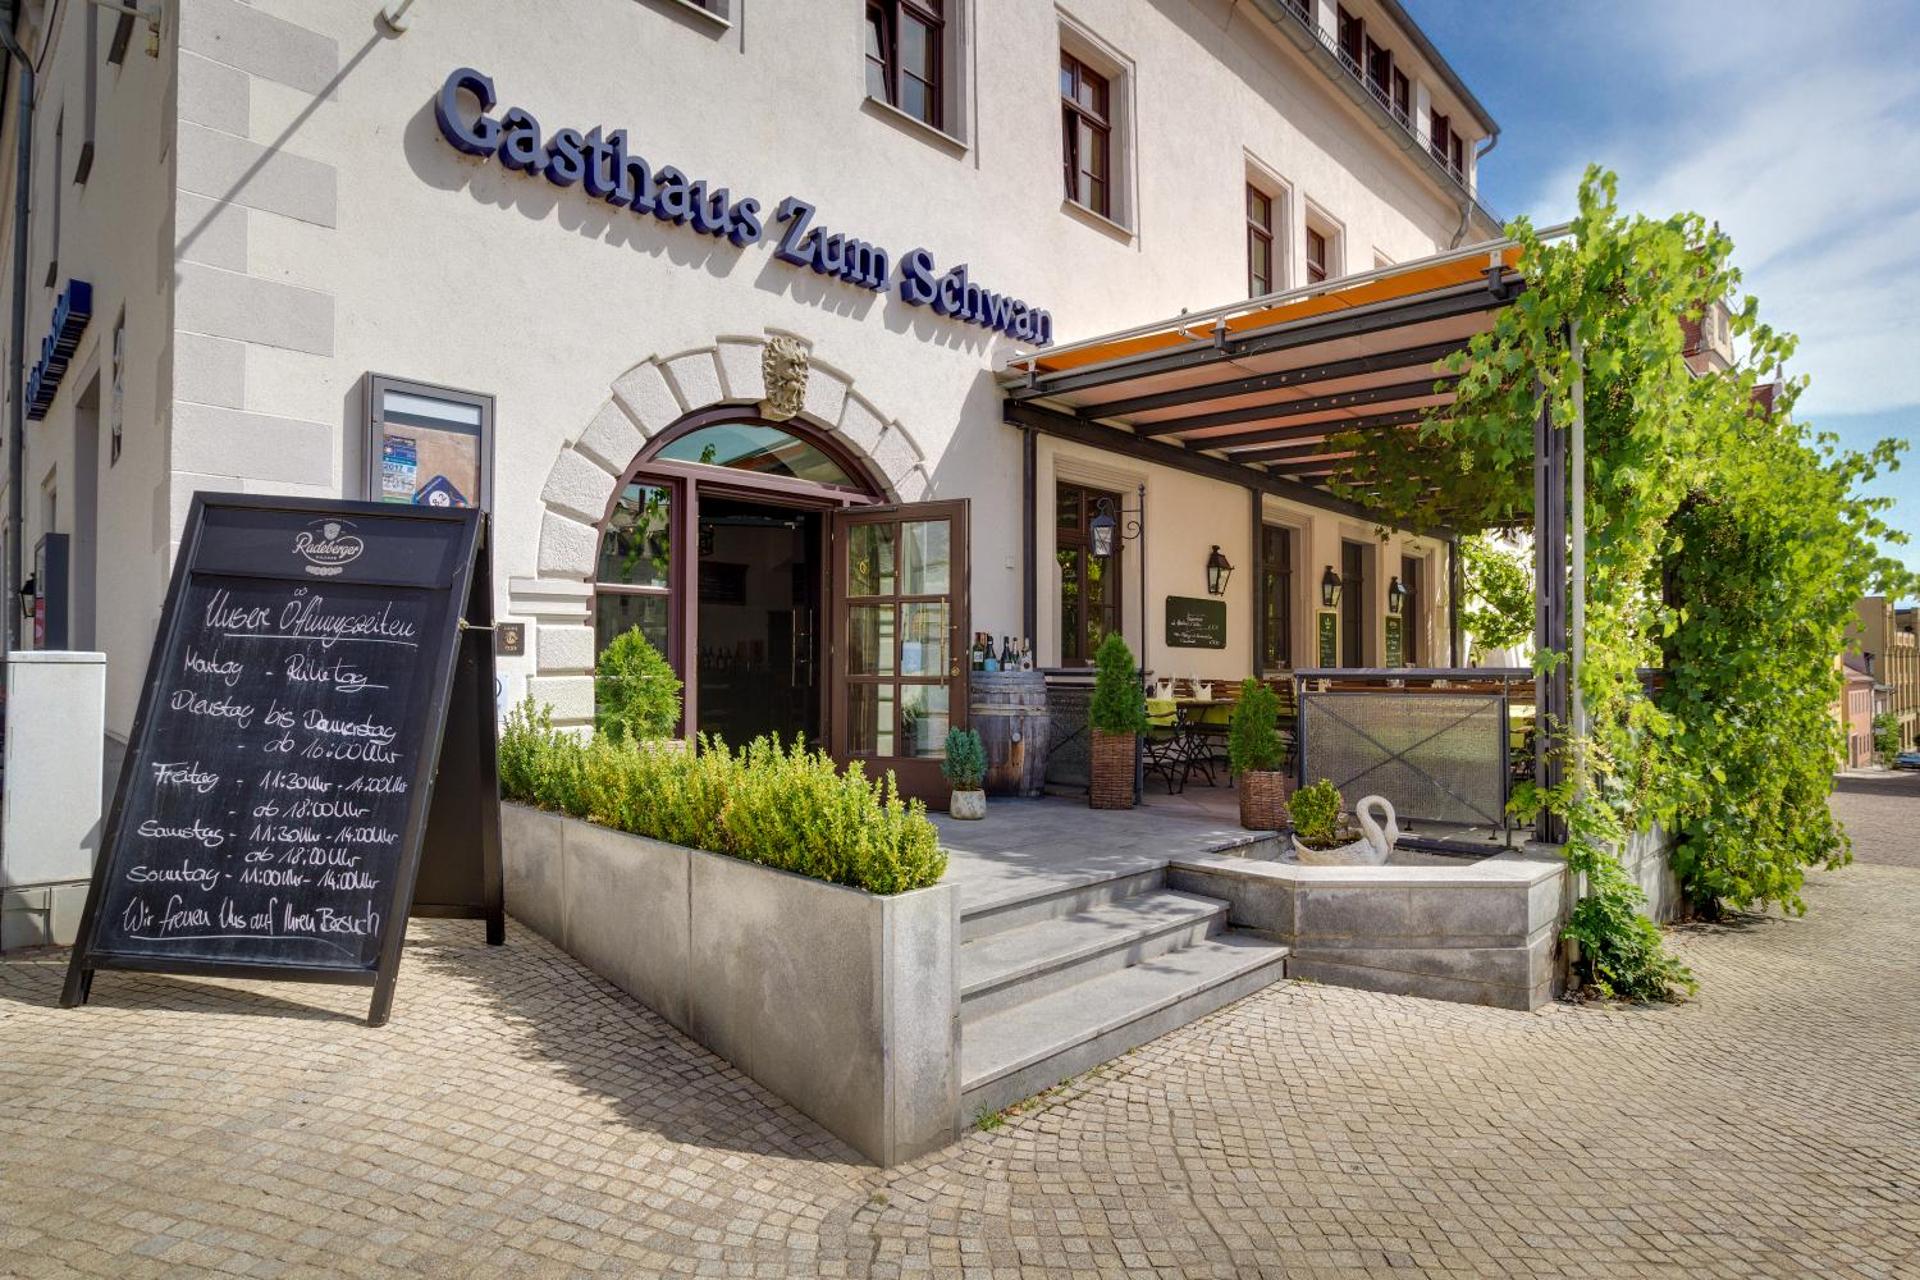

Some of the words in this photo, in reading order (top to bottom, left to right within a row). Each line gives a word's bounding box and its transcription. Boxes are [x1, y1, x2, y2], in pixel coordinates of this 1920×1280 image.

[435, 67, 763, 248] Gasthaus
[774, 196, 891, 293] Zum
[900, 247, 1054, 348] Schwan
[292, 532, 361, 560] Radeberger
[184, 645, 243, 686] Montag
[285, 653, 386, 693] Ruhetag
[171, 689, 255, 729] Dienstag
[264, 699, 295, 728] bis
[264, 731, 295, 752] ab
[152, 761, 220, 793] Freitag
[253, 800, 279, 817] ab
[137, 819, 225, 847] Samstag
[245, 849, 275, 863] ab
[127, 859, 218, 891] Sonntag
[123, 896, 153, 931] Wir
[160, 894, 210, 937] freuen
[220, 897, 247, 930] Uns
[250, 897, 278, 934] auf
[284, 901, 316, 932] Ihren
[315, 900, 380, 937] Besuch
